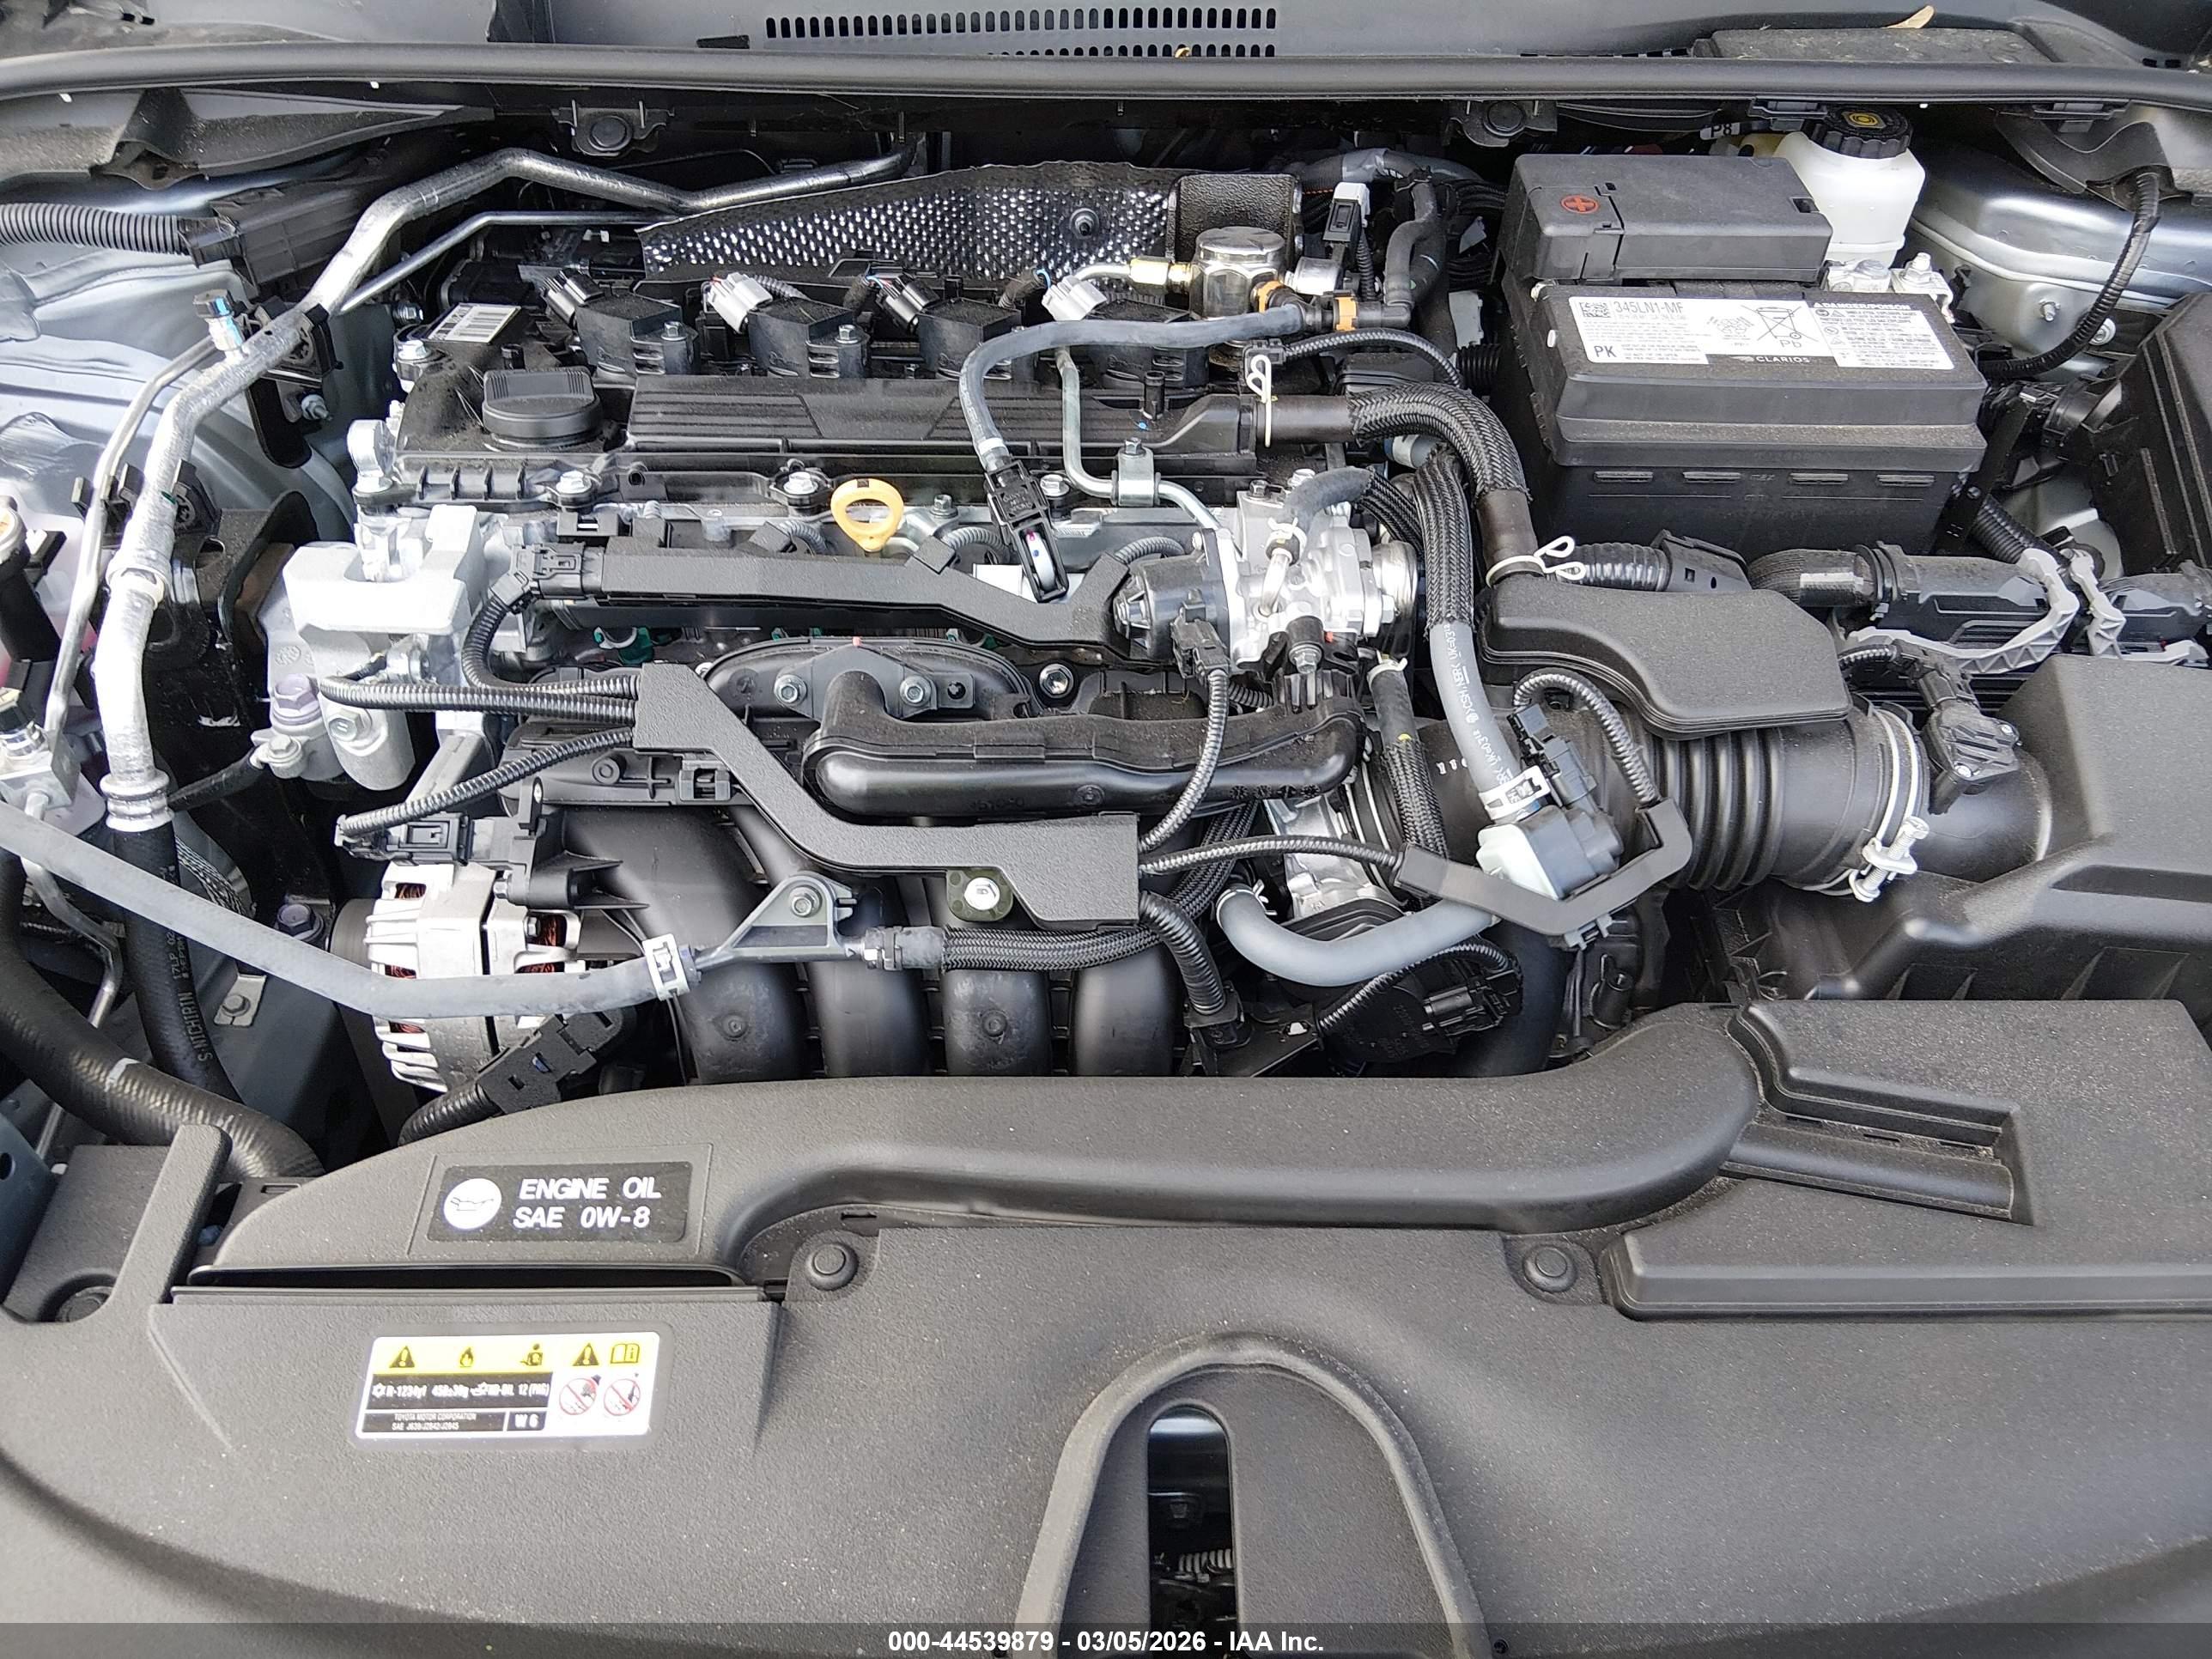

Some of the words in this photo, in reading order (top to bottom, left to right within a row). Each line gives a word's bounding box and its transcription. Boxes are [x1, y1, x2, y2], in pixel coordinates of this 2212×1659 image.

[1711, 124, 1732, 137] P8
[1613, 301, 1684, 313] 345LN1-MF
[1779, 339, 1802, 348] Pb
[1594, 345, 1618, 357] PK
[519, 1177, 610, 1200] ENGINE
[623, 1176, 662, 1199] OIL
[513, 1206, 565, 1228] SAE
[580, 1206, 651, 1228] 0W-8
[394, 1413, 416, 1421] TOYOTA
[416, 1413, 436, 1421] MOTOR
[437, 1413, 477, 1421] CORPORATION
[515, 1413, 527, 1427] W
[392, 1422, 404, 1431] SAE
